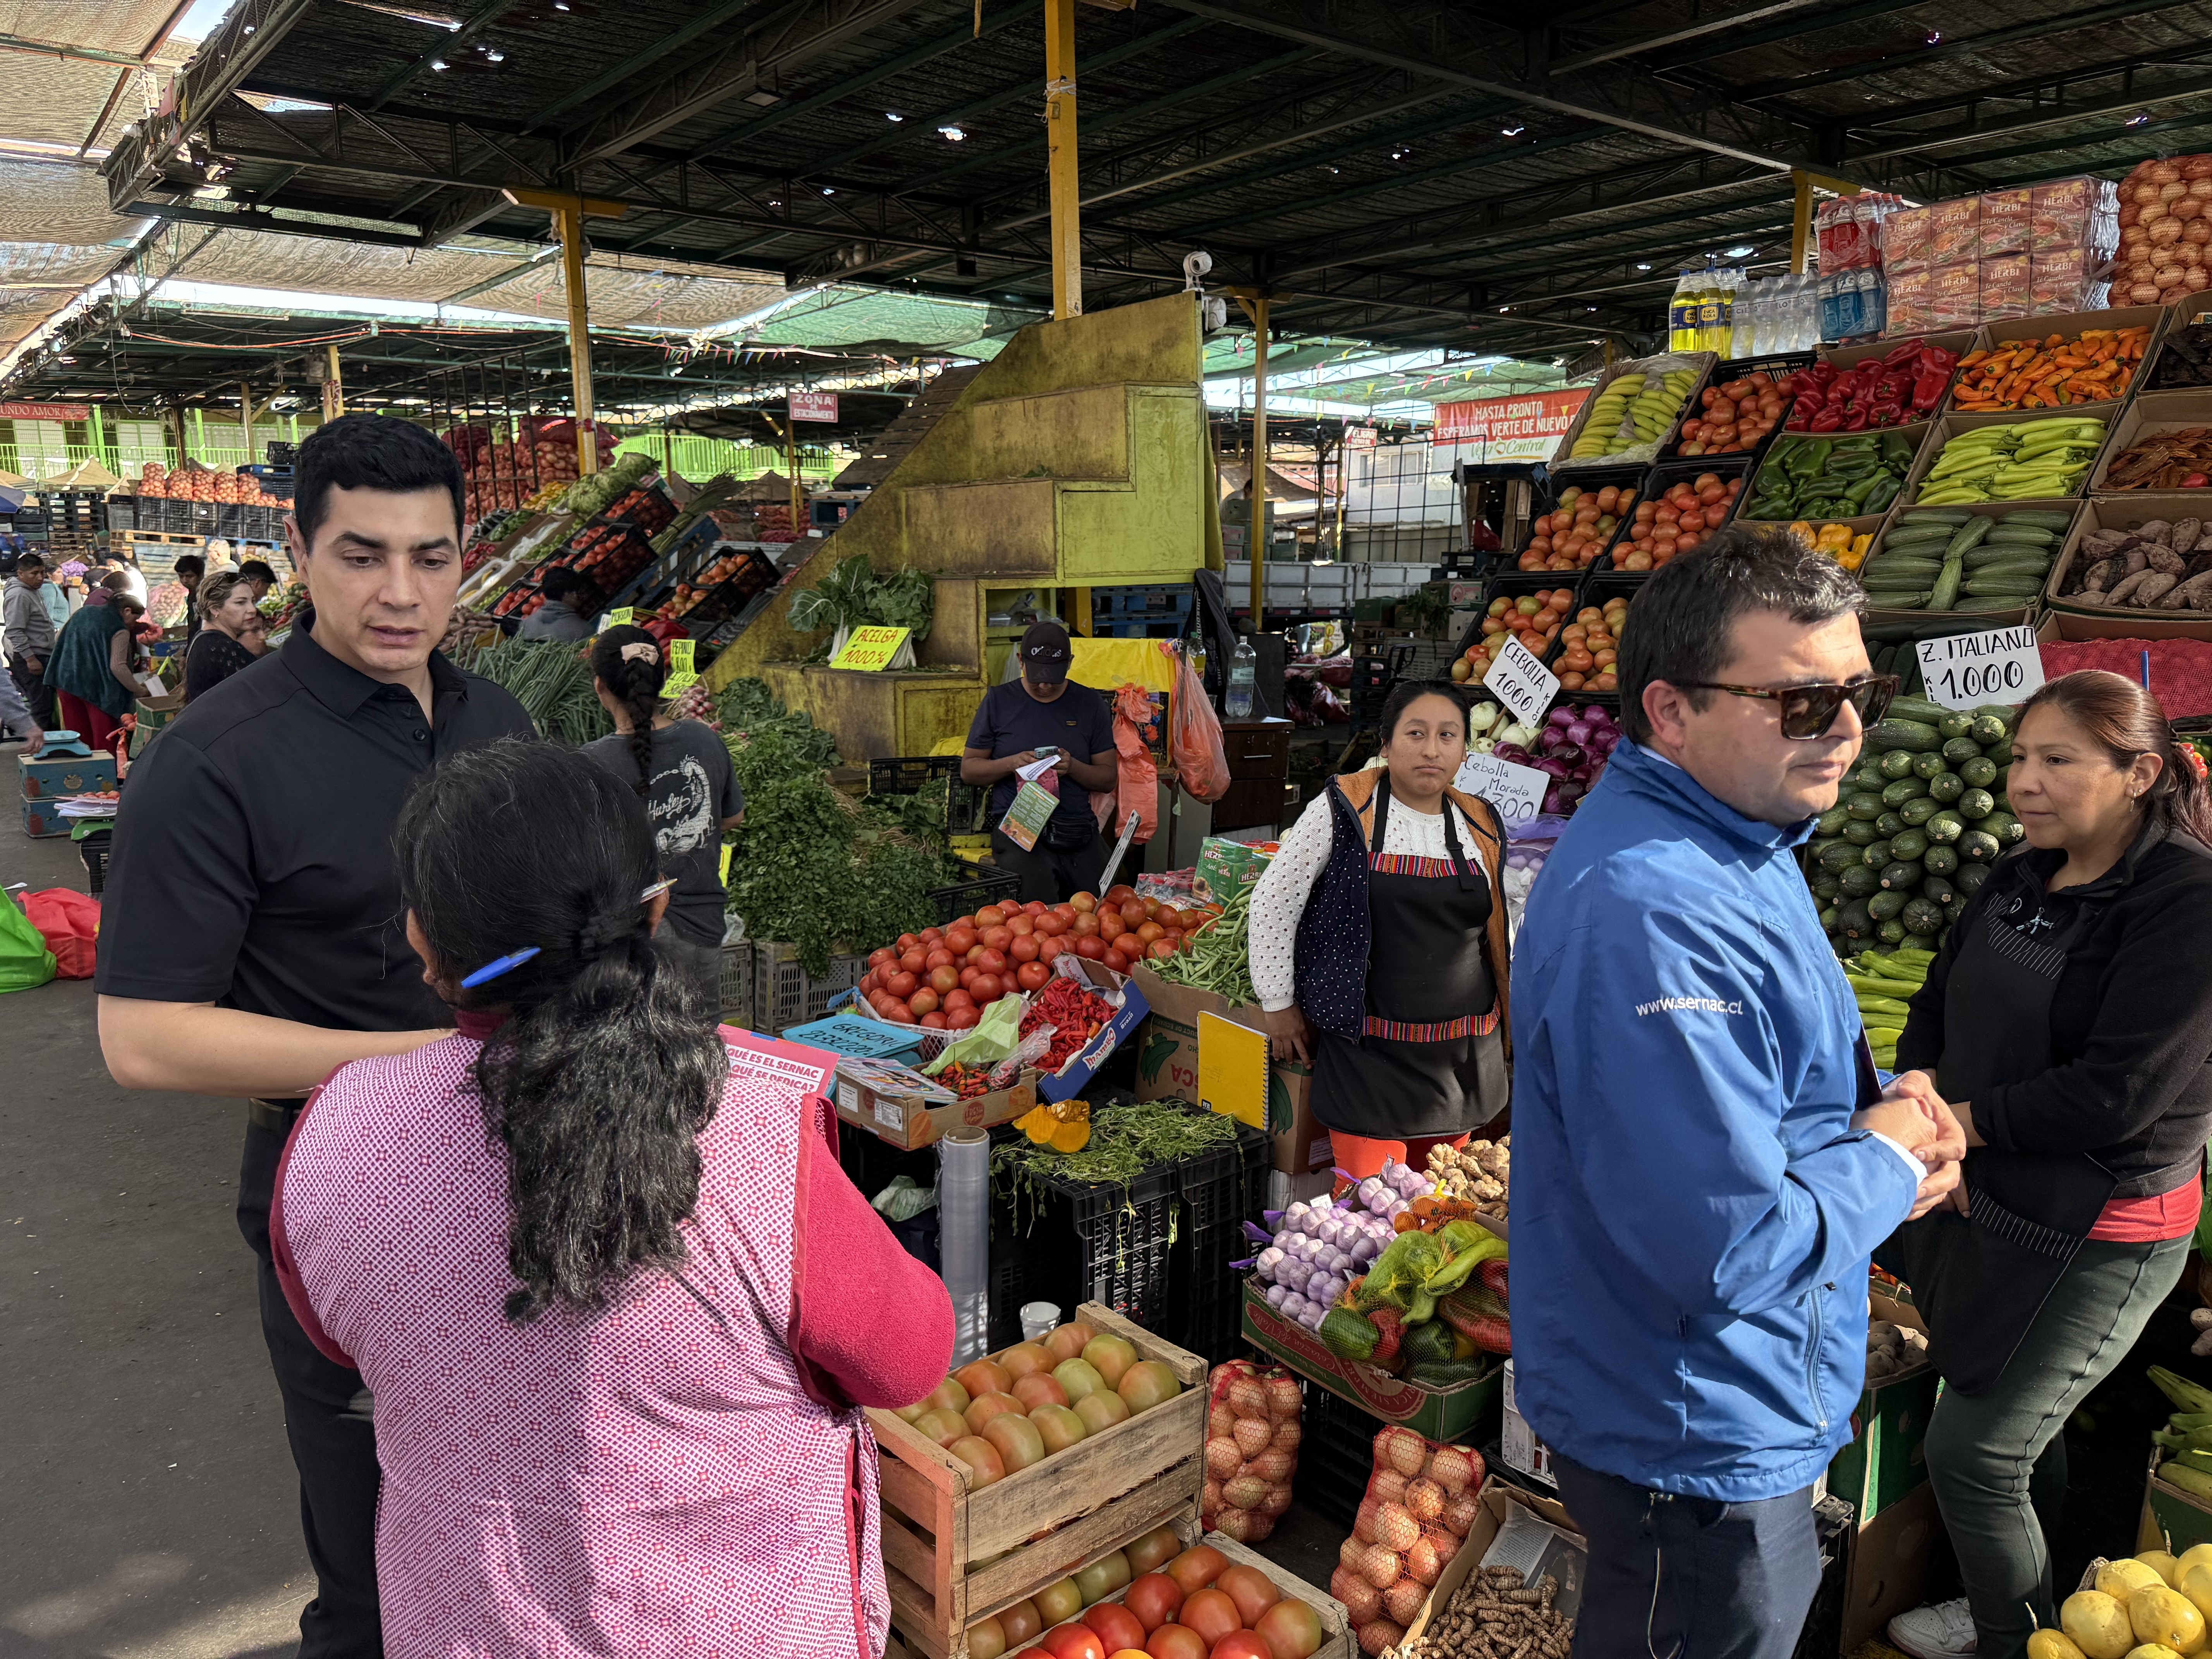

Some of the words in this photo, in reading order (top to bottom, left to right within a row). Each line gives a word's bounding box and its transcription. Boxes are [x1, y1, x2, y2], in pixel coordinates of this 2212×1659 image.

[1992, 203, 2021, 215] HERBI
[2044, 195, 2073, 206] HERBI
[1941, 211, 1969, 223] HERBI
[1990, 268, 2019, 280] HERBI
[2042, 262, 2072, 273] HERBI
[1894, 284, 1921, 296] HERBI
[1941, 276, 1968, 288] HERBI
[0, 405, 29, 415] UNDO
[32, 406, 61, 416] AMOR
[1475, 405, 1505, 421] HASTA
[1507, 401, 1543, 418] PRONTO
[1491, 420, 1520, 436] VERTE
[1522, 419, 1534, 434] DE
[1536, 416, 1568, 433] NUEVO
[1506, 438, 1546, 455] Central
[855, 629, 898, 643] ACELGA
[1948, 628, 2034, 659] ITALIANO
[844, 650, 876, 664] 1000
[1031, 646, 1062, 657] adidas
[1504, 642, 1546, 692] CEBOLLA
[1940, 661, 2023, 700] 1.000
[1532, 693, 1550, 721] KILO
[1465, 754, 1509, 778] Cebolla
[1489, 778, 1529, 796] Morada
[1635, 997, 1743, 1017] www.sernac.cl
[727, 1047, 749, 1060] QUÉ
[749, 1054, 763, 1063] ES
[763, 1057, 775, 1068] EL
[776, 1061, 819, 1079] SERNAC
[731, 1064, 755, 1077] QUÉ
[755, 1070, 769, 1079] SE
[769, 1073, 815, 1092] DEDICA?
